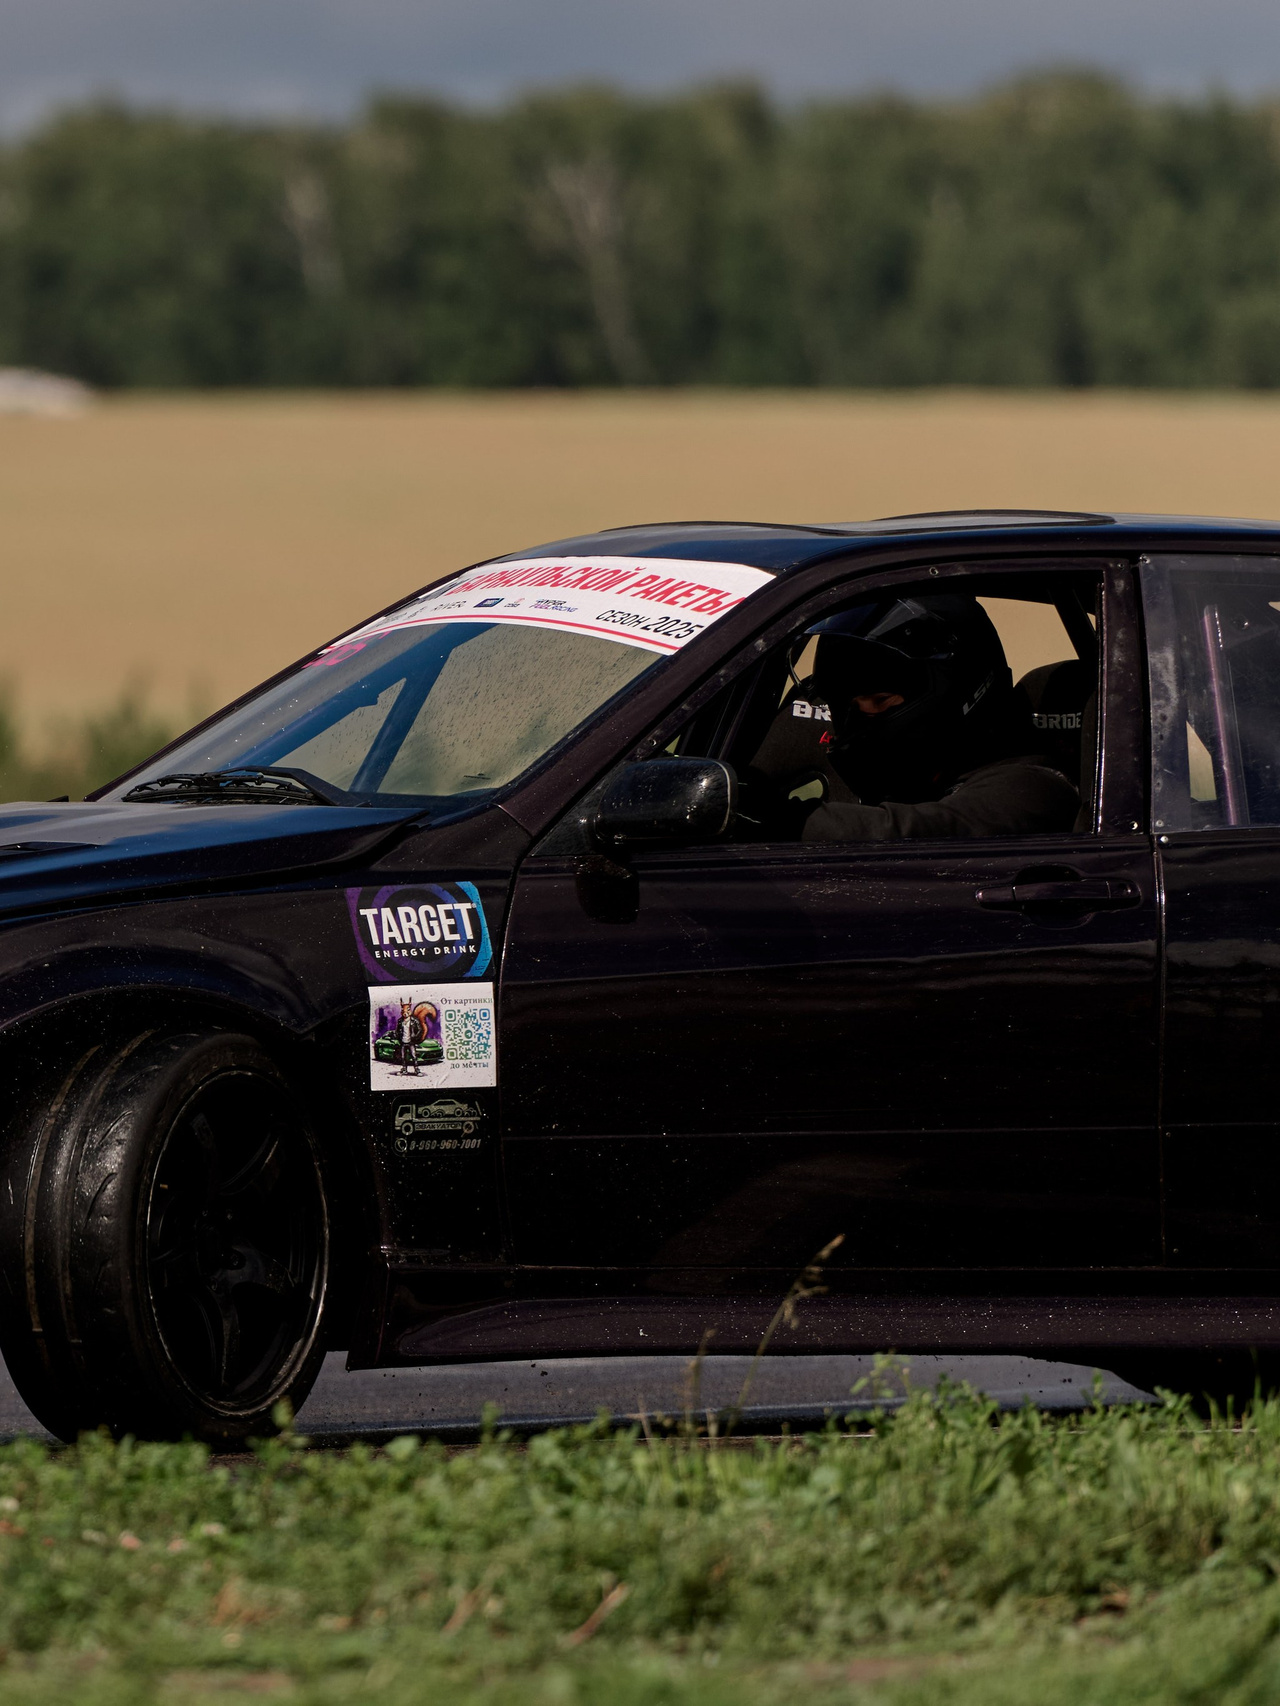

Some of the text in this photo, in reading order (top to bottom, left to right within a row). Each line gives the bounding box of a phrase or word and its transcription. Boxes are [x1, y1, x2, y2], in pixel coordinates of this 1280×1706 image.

[630, 574, 748, 616] РАКЕТЫ
[595, 609, 705, 639] СЕЗОН 2025
[359, 902, 474, 945] TARGET
[374, 944, 477, 959] ENERGY DRINK
[440, 996, 493, 1006] От картинки
